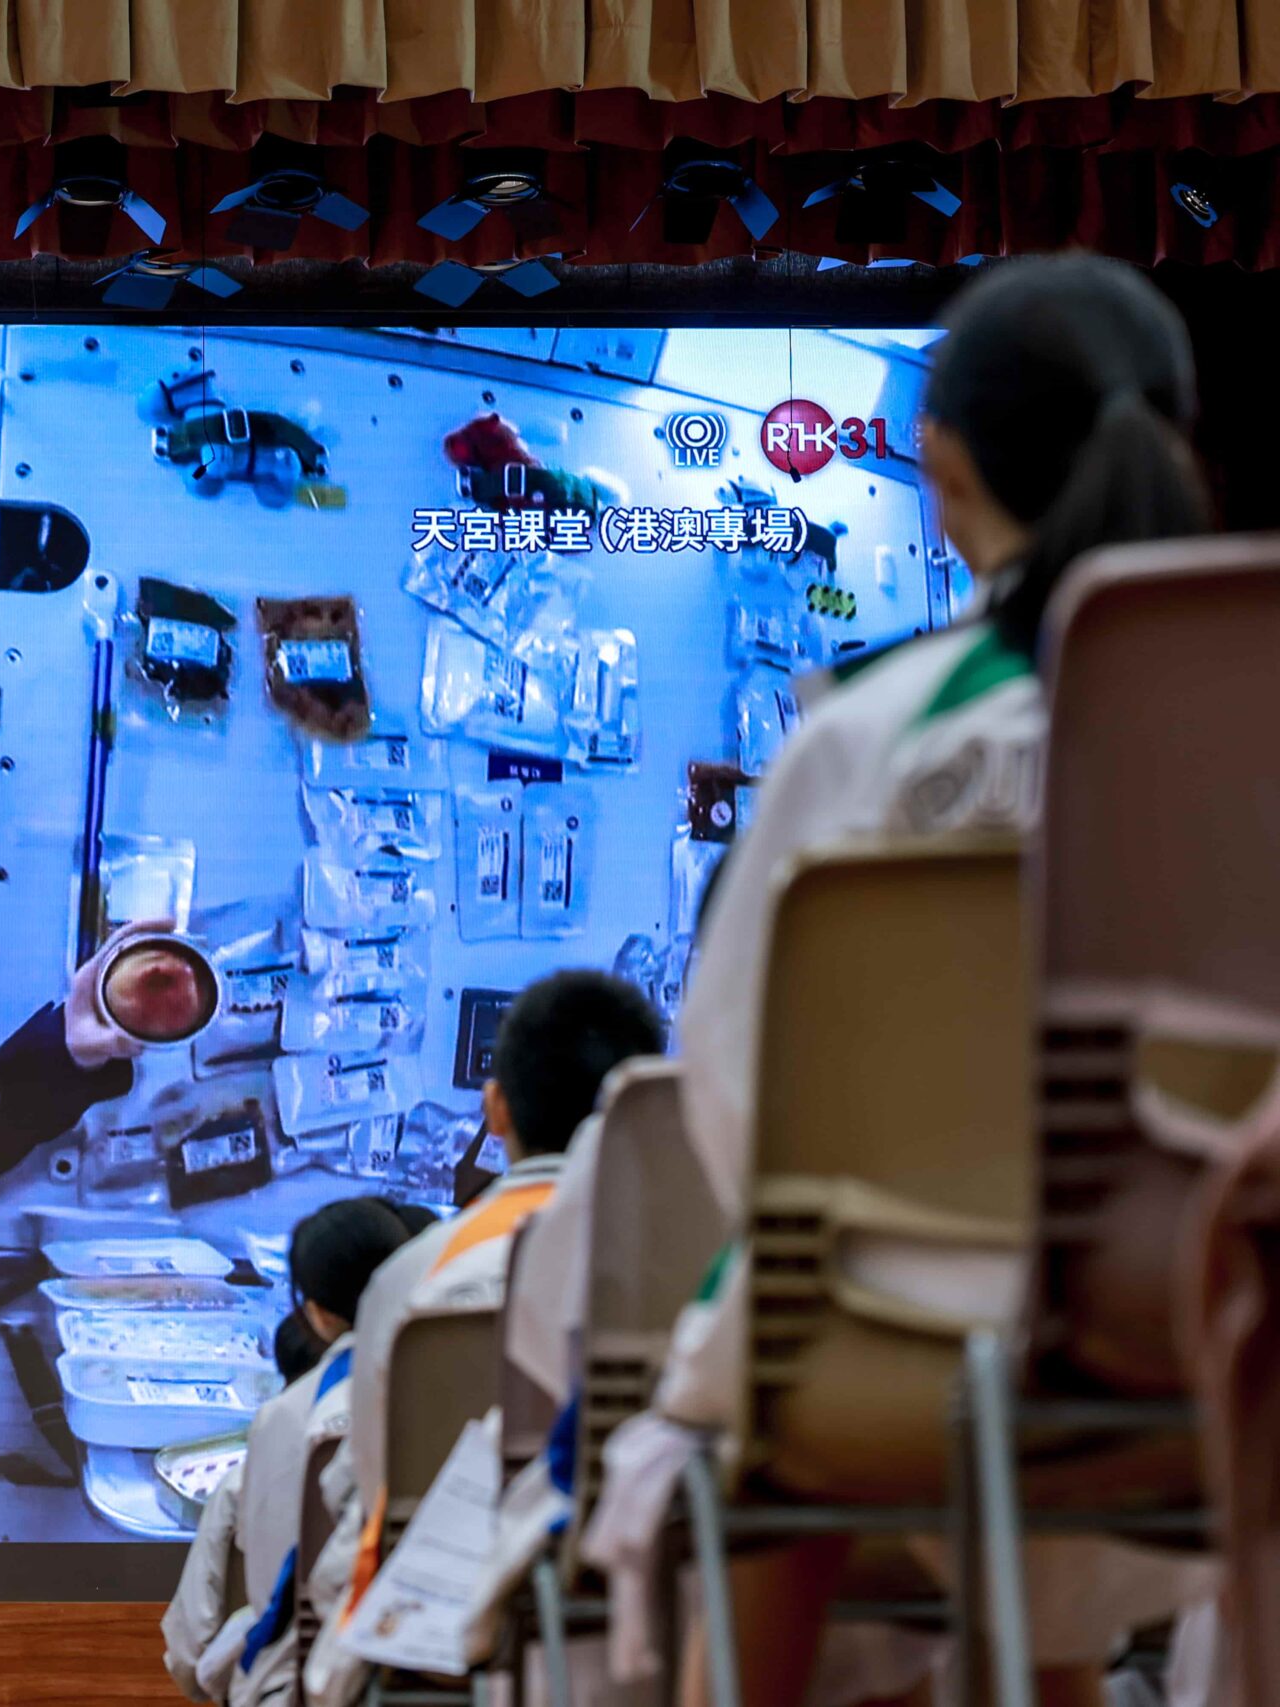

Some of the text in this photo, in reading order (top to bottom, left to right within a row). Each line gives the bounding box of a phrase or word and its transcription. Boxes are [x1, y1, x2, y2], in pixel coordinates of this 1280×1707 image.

[673, 448, 720, 467] LIVE
[840, 416, 887, 459] 31
[412, 506, 808, 553] 天宮課堂(港澳專場)
